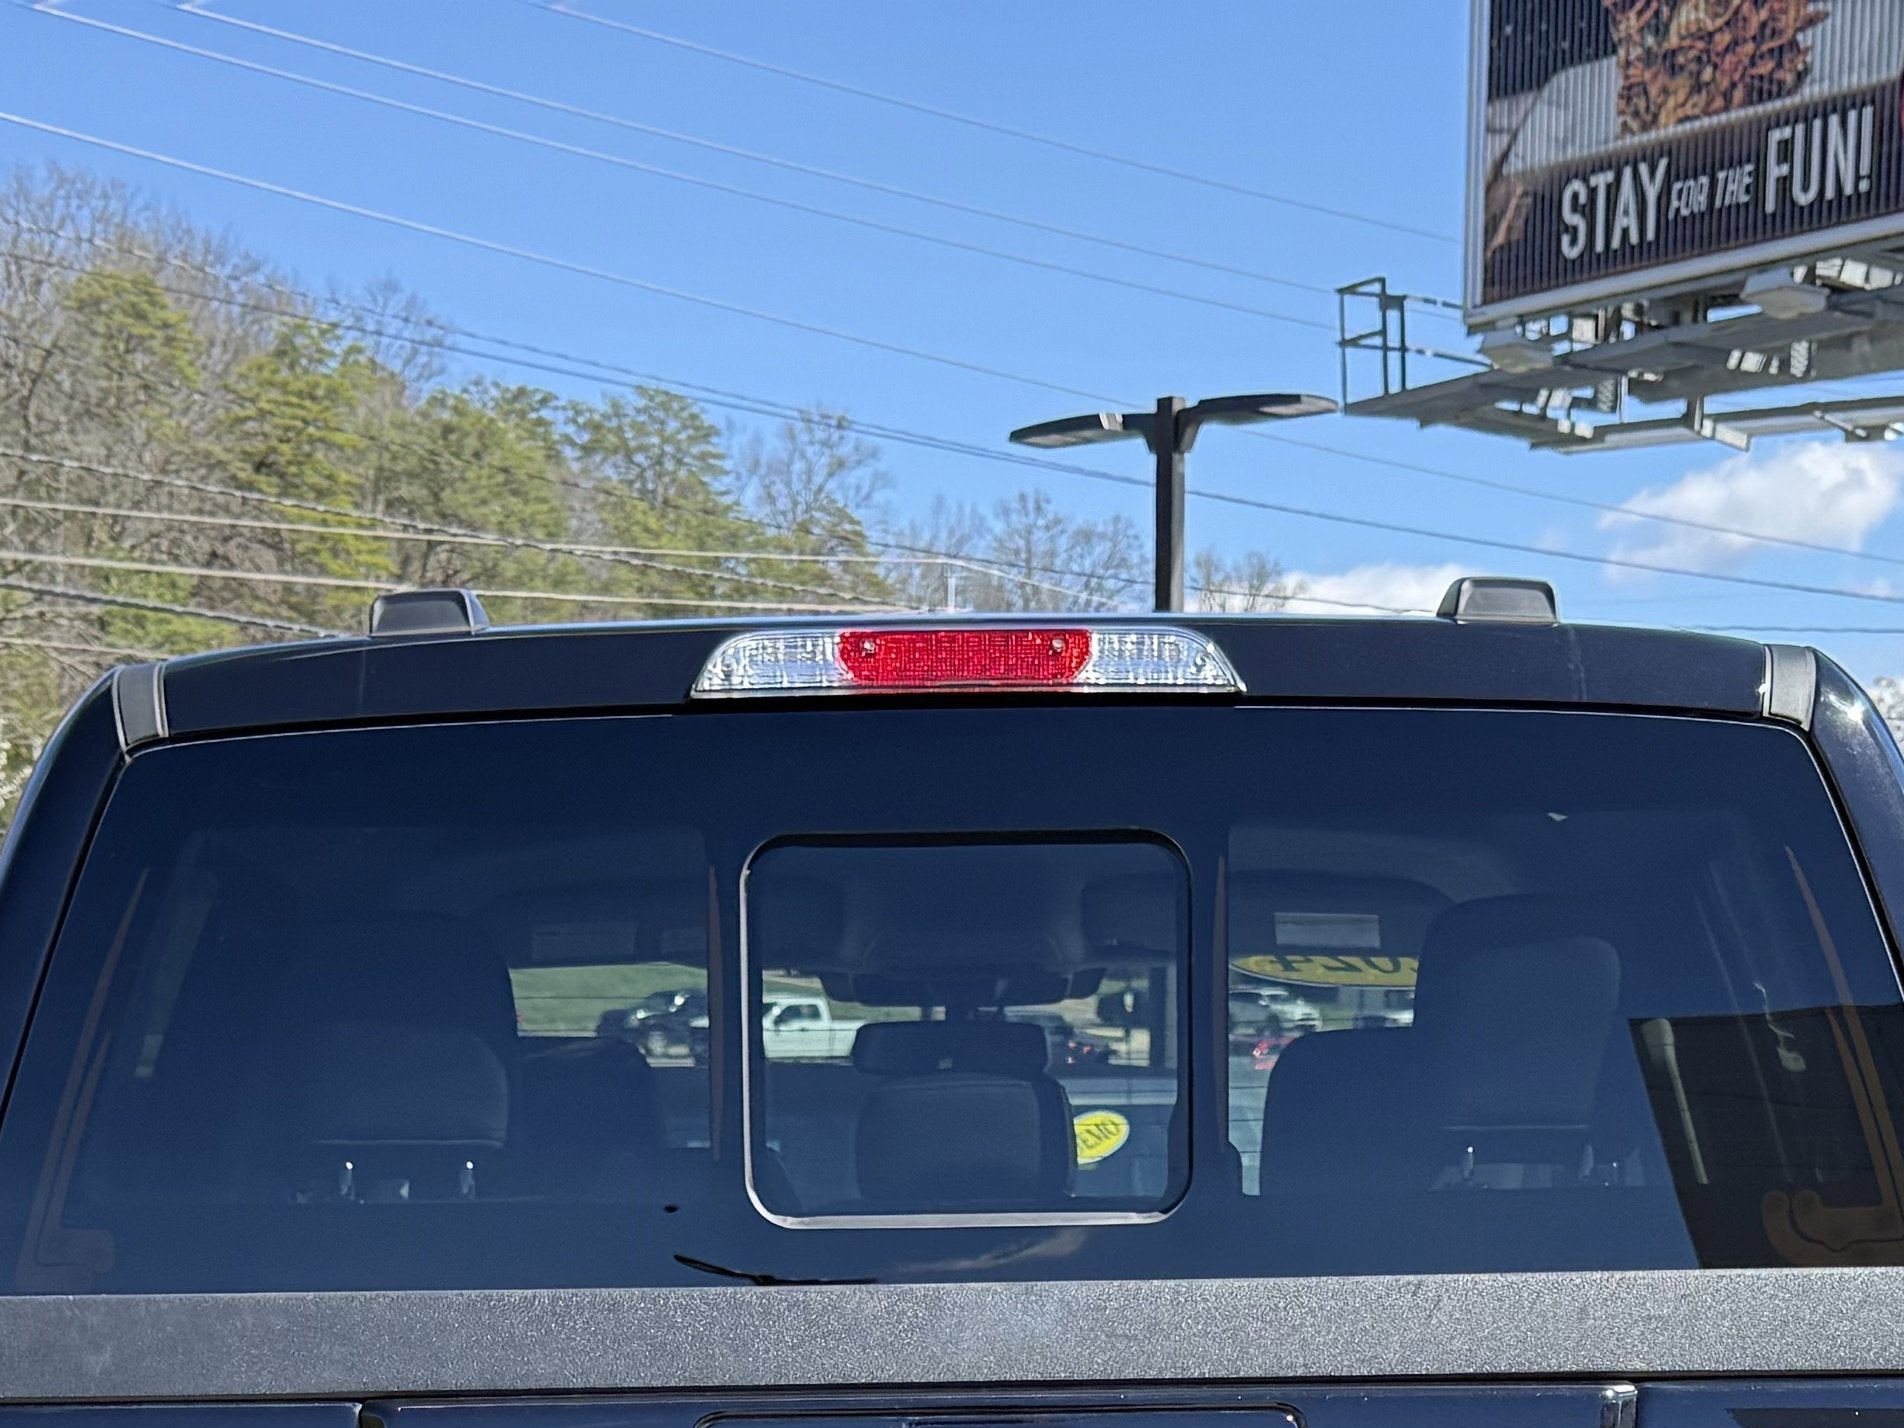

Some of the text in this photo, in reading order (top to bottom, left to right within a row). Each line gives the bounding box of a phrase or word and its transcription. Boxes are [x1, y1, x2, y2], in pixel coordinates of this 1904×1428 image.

[1560, 156, 1670, 261] STAY
[1667, 176, 1709, 222] FOR
[1713, 162, 1757, 210] THE
[1763, 104, 1875, 215] FUN!
